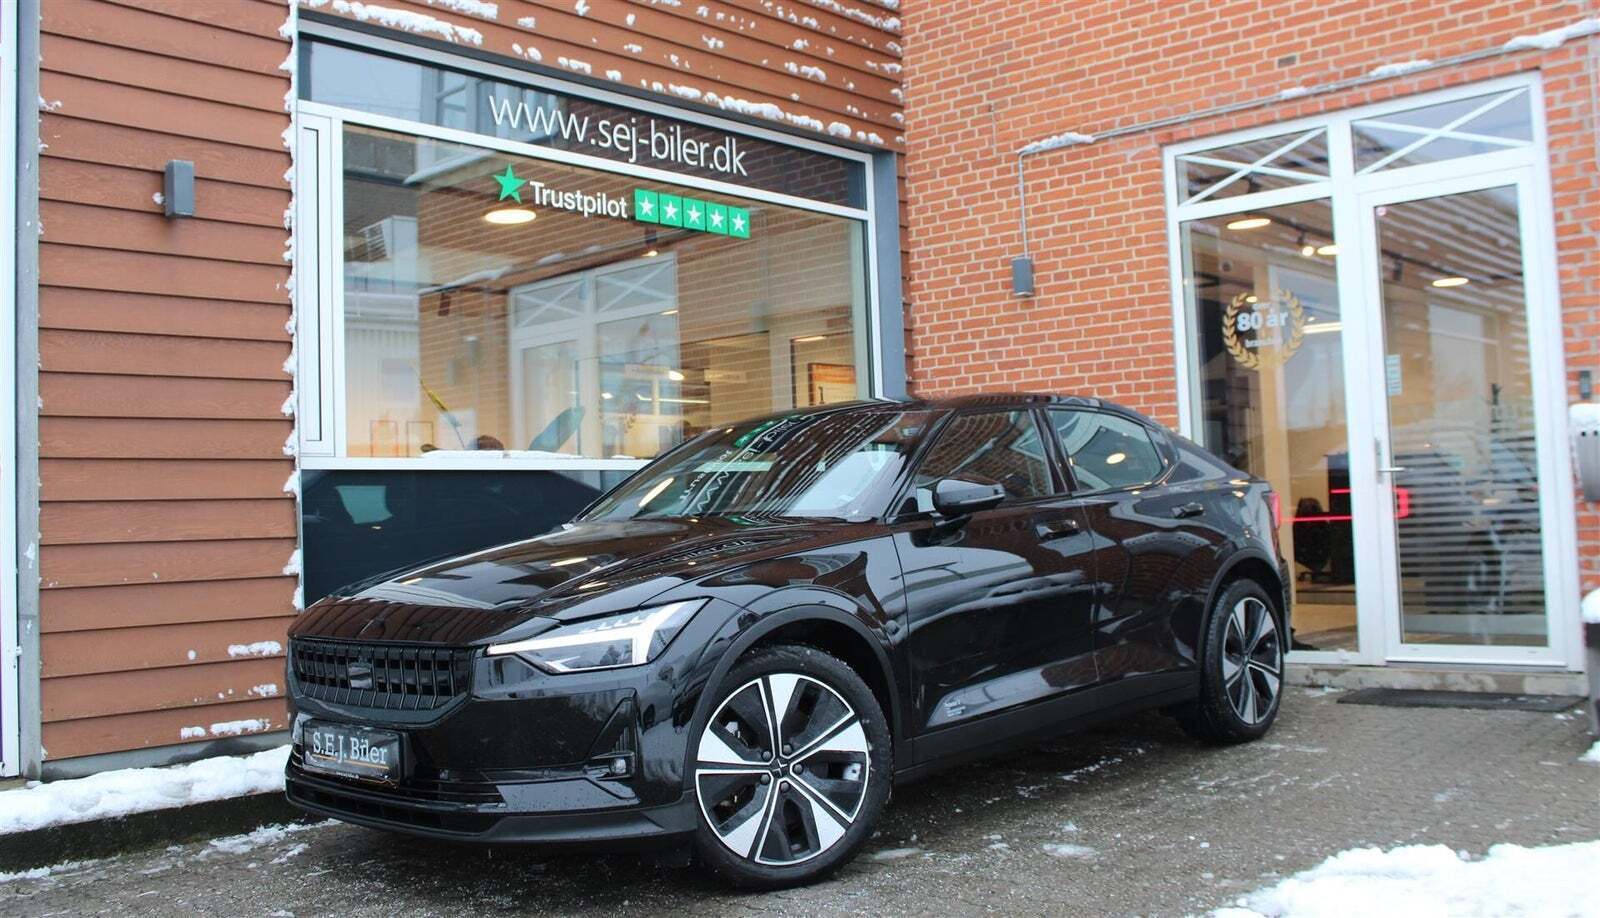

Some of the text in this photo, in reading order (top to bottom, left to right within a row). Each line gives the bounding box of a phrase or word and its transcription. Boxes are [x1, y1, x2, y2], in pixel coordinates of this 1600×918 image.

[489, 96, 747, 176] www.sej-biler.dk
[529, 181, 628, 219] Trustpilot
[1237, 311, 1262, 331] 80
[313, 731, 387, 764] S.E.J. Biler
